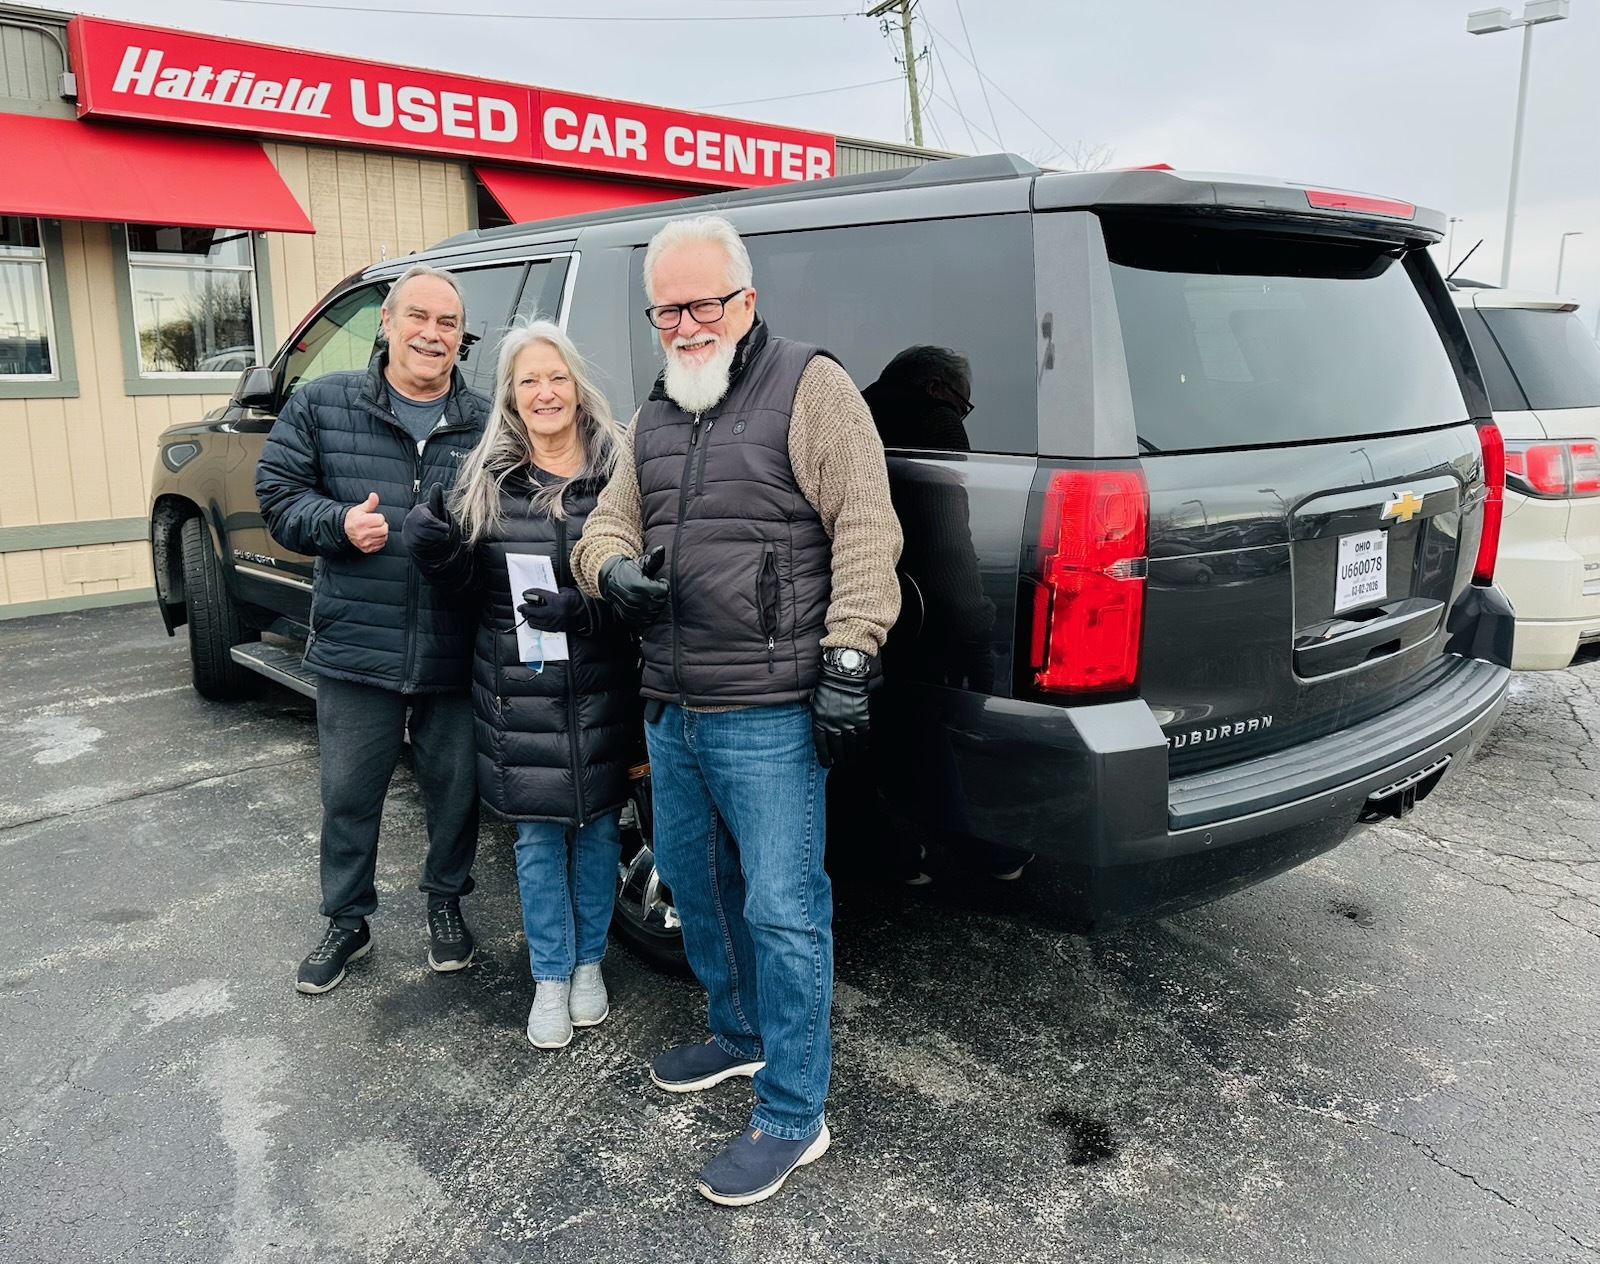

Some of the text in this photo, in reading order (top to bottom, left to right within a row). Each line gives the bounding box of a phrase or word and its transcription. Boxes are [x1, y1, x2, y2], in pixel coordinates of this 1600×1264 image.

[112, 46, 831, 181] Hatfield USED CAR CENTER
[1355, 541, 1370, 552] OHIO
[1342, 557, 1382, 579] U660078
[1352, 581, 1378, 596] 03-02-2026
